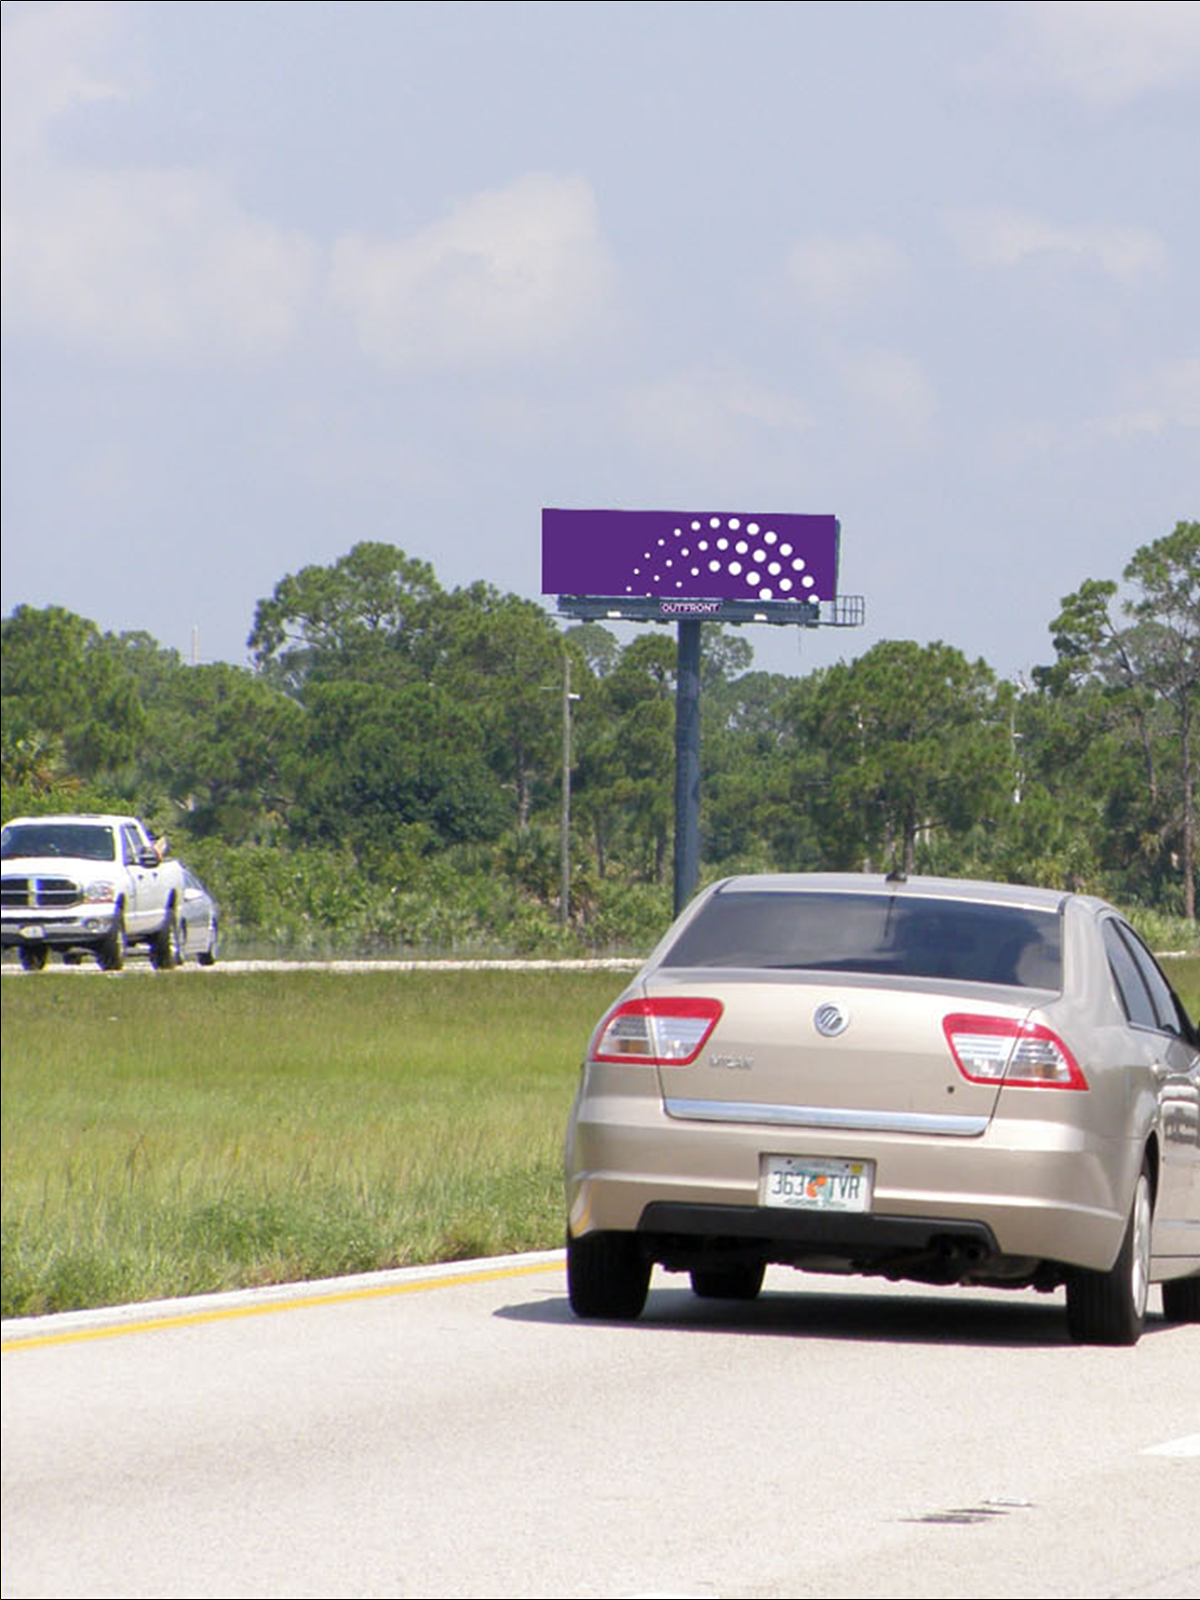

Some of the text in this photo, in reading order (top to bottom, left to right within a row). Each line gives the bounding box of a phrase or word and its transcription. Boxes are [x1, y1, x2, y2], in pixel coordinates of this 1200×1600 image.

[661, 602, 720, 613] OUTFRONT
[771, 1170, 861, 1200] 363 TVR
